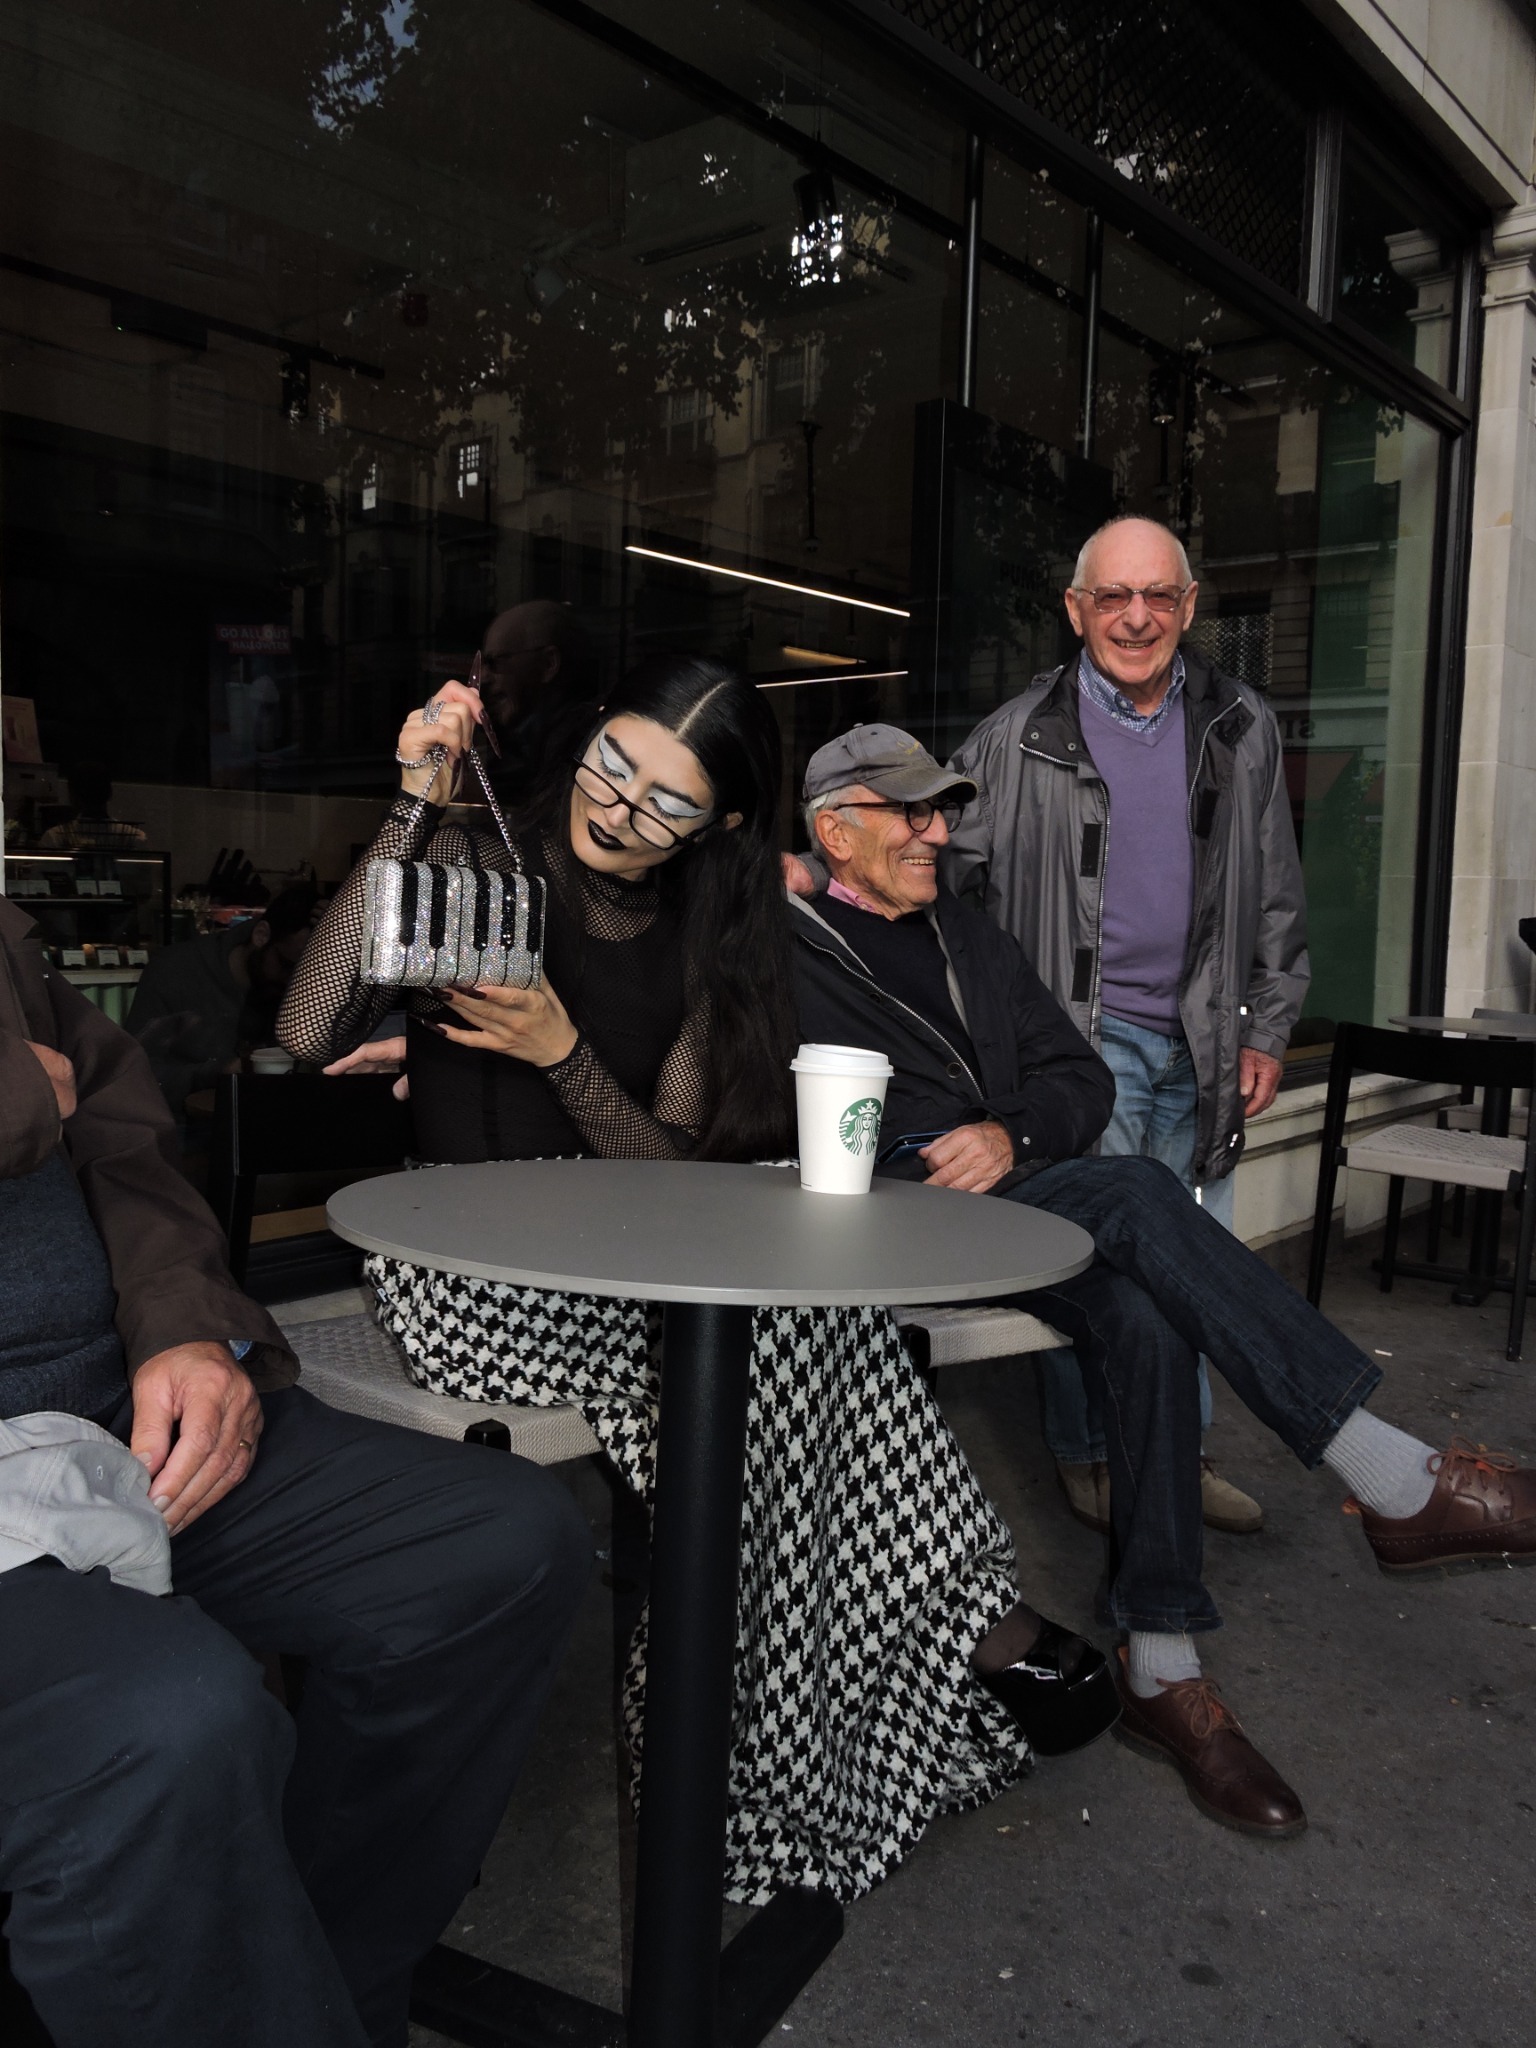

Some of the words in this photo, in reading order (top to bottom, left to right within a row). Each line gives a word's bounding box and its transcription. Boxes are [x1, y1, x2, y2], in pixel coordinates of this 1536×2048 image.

[220, 627, 238, 639] GO
[240, 627, 262, 640] ALL
[264, 628, 288, 640] OUT
